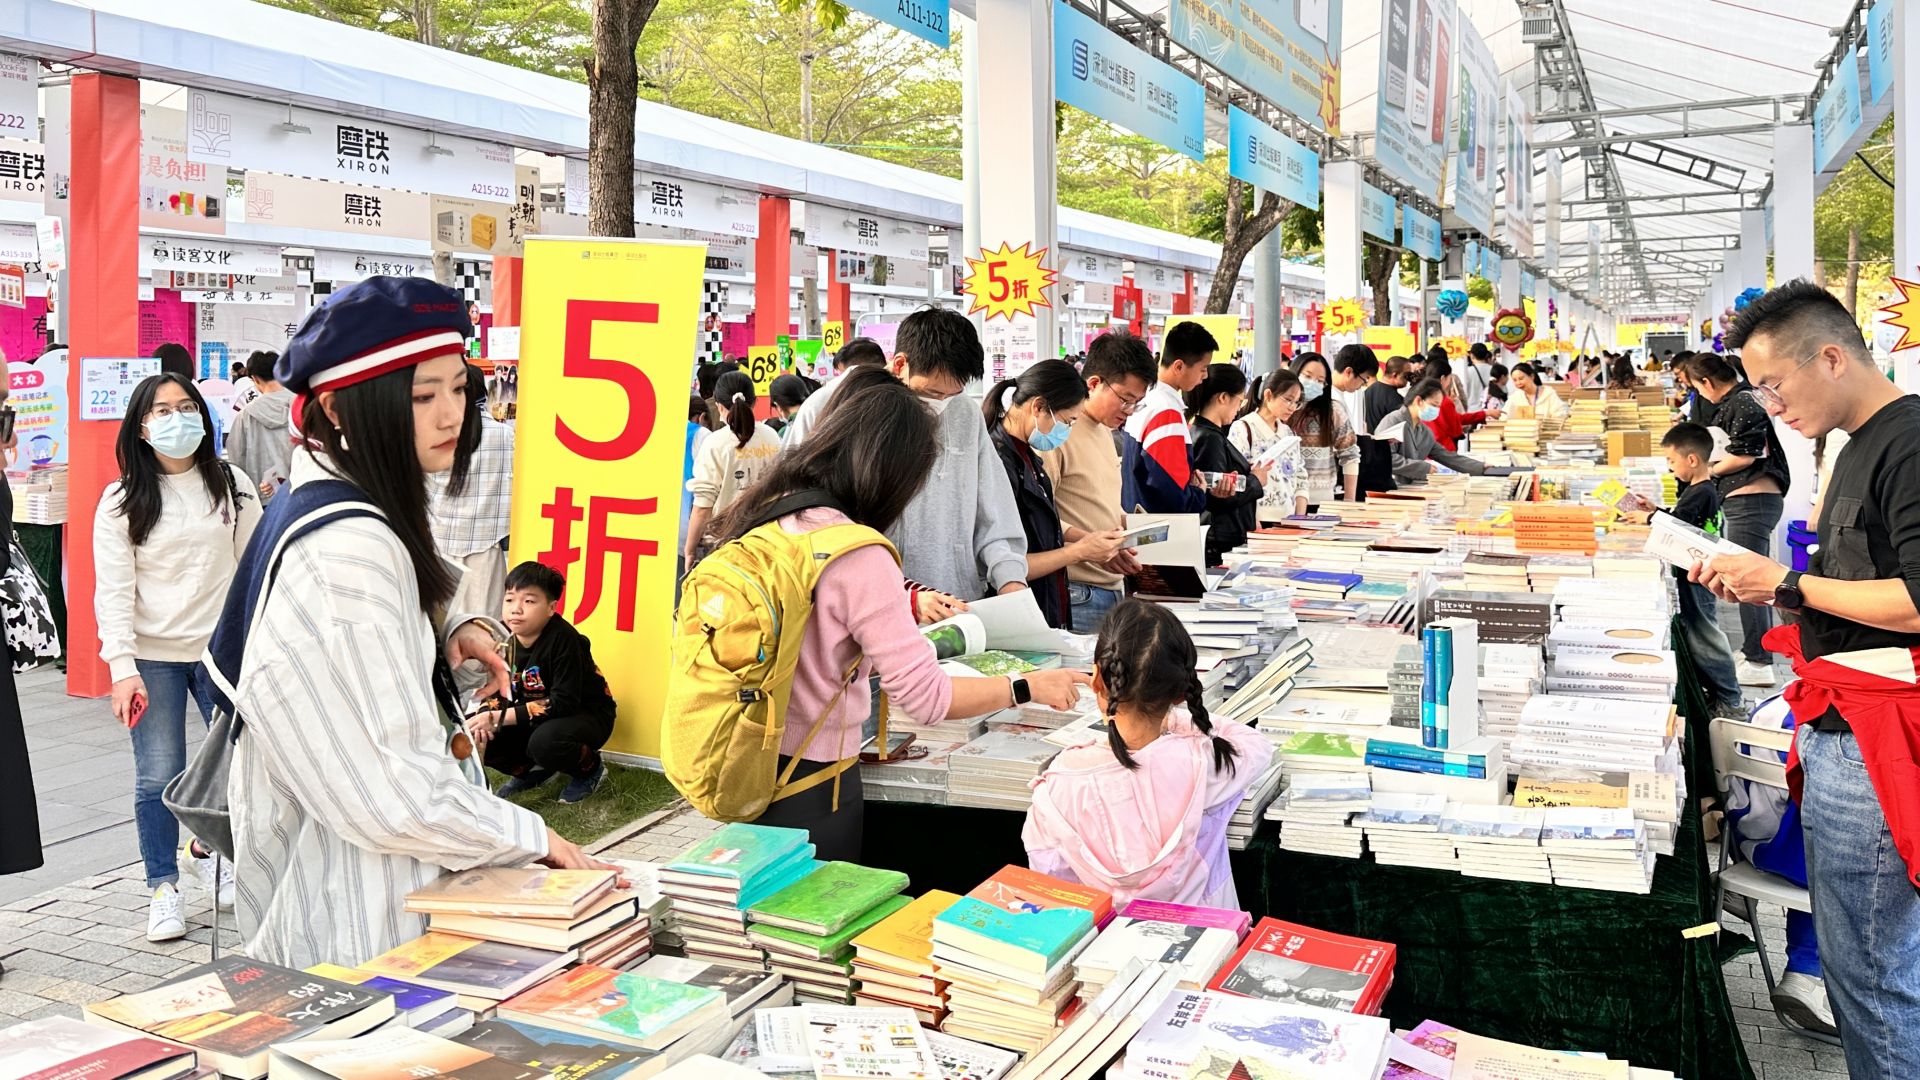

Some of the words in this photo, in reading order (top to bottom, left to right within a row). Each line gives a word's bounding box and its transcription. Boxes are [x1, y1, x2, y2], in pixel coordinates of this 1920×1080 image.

[1092, 51, 1136, 93] 深圳出版集团
[1147, 82, 1178, 115] 深圳出版社
[337, 125, 390, 162] 磨铁
[337, 158, 390, 175] XIRON
[472, 183, 509, 198] A215-222
[652, 181, 683, 208] 磨铁
[345, 194, 382, 218] 磨铁
[652, 206, 683, 219] XIRON
[345, 216, 381, 227] XIRON
[172, 246, 232, 266] 读客文化
[369, 261, 415, 277] 读客文化
[988, 260, 1030, 303] 5折
[1331, 306, 1355, 327] 5折
[13, 373, 37, 386] 大众
[91, 390, 109, 405] 22
[537, 299, 660, 633] 5折
[286, 991, 357, 1020] 伟大
[1166, 994, 1201, 1028] 左岸右岸
